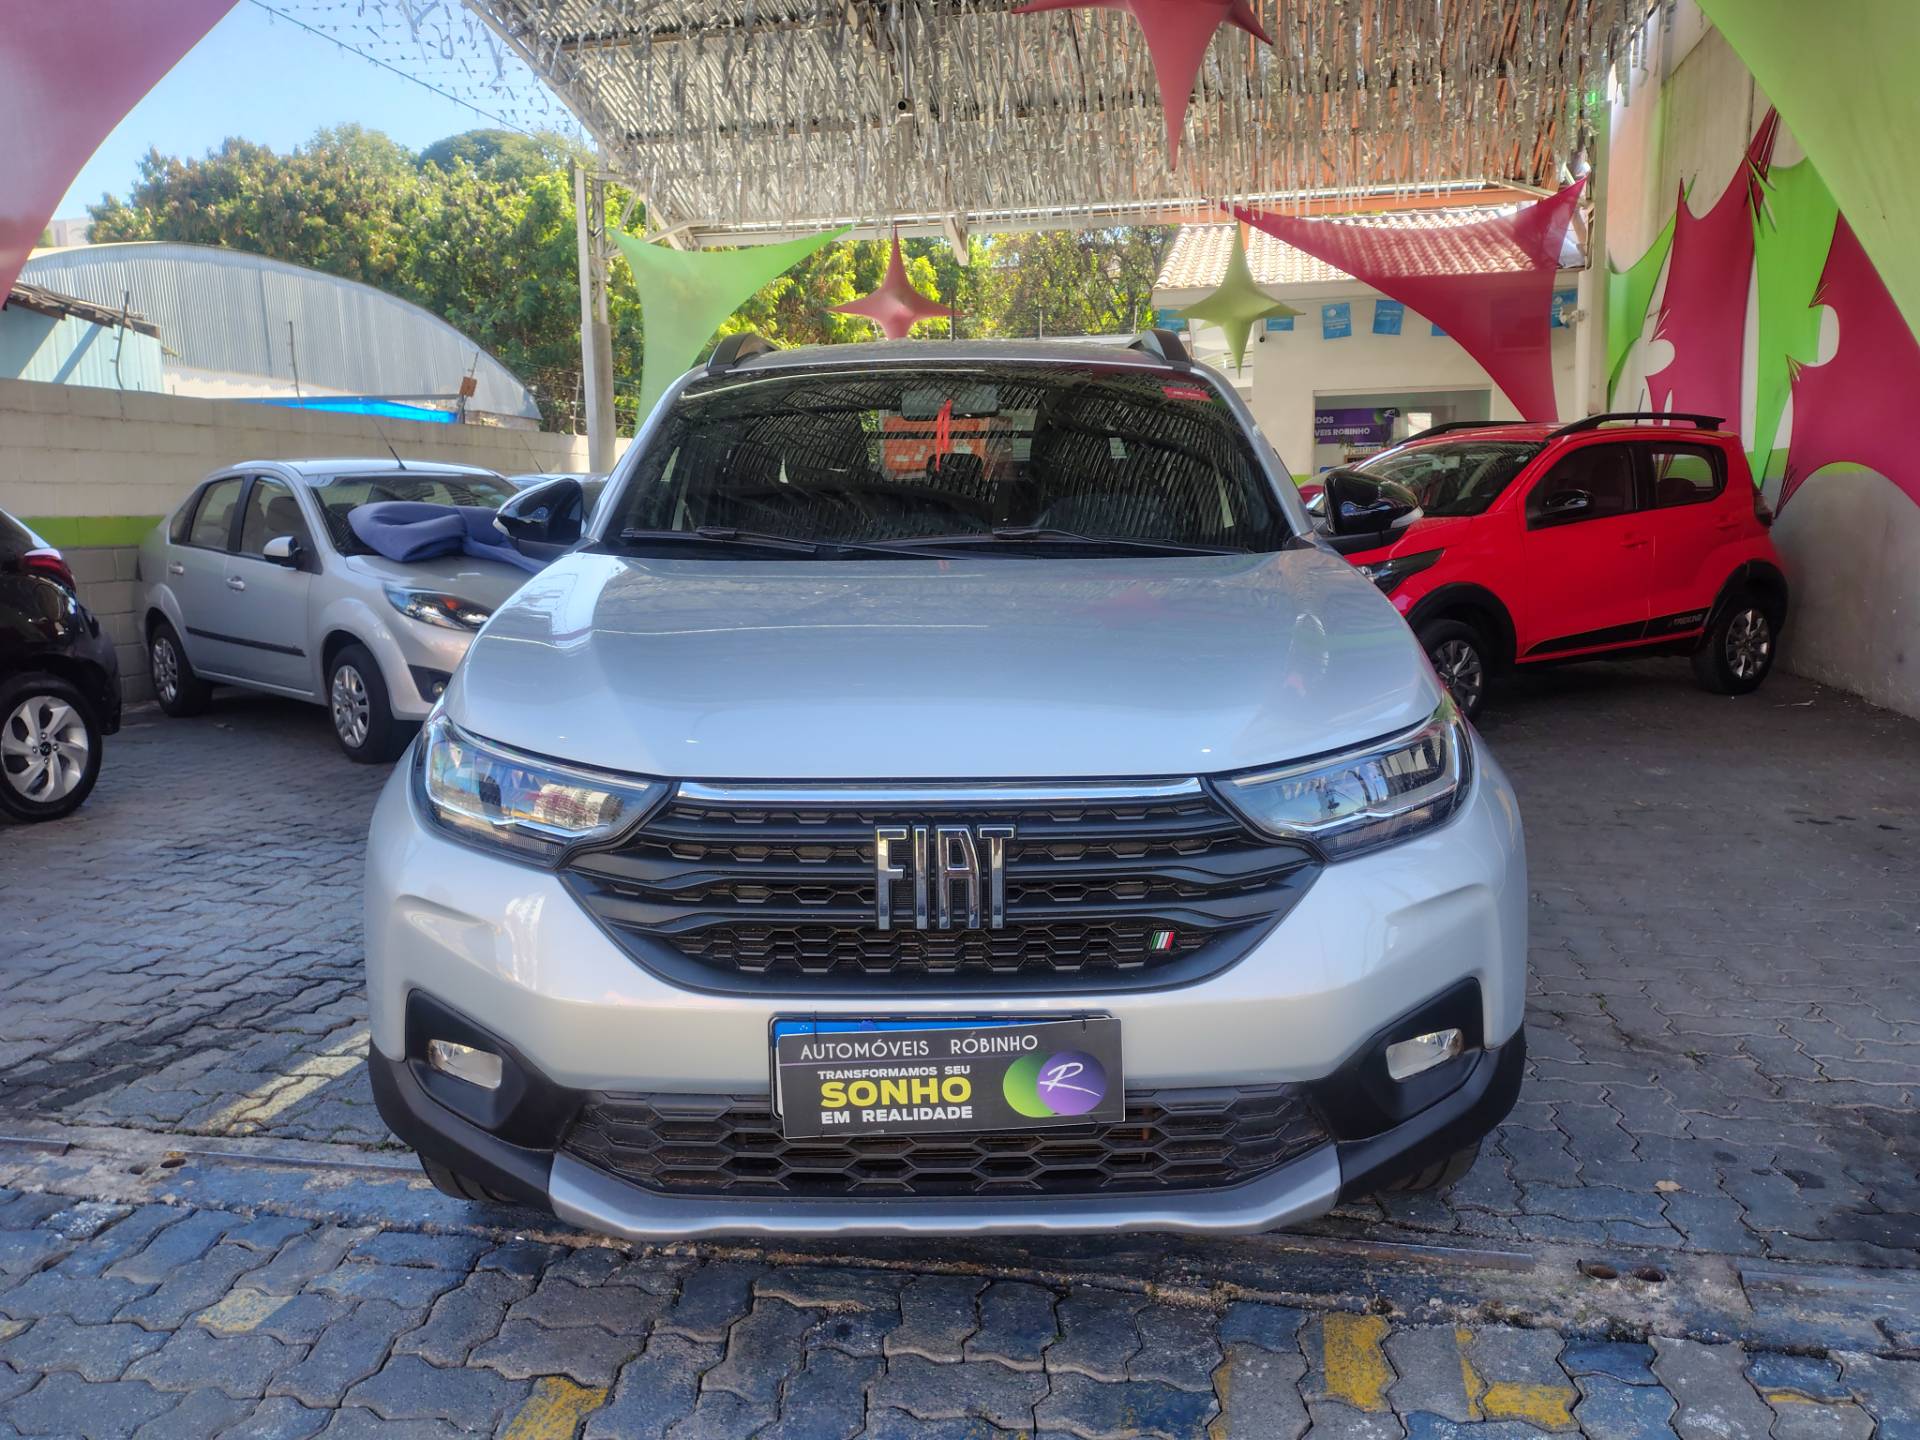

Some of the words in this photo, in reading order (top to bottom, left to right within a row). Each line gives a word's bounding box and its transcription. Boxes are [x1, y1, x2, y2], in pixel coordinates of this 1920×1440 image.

[875, 824, 1016, 930] FIAT
[800, 1038, 930, 1060] AUTOMÓVEIS
[817, 1066, 938, 1080] TRANSFORMAMOS
[944, 1065, 971, 1075] SEU
[1040, 1062, 1101, 1097] R
[820, 1076, 972, 1108] SONHO
[821, 1110, 850, 1125] EM
[862, 1106, 973, 1123] REALIDADE
